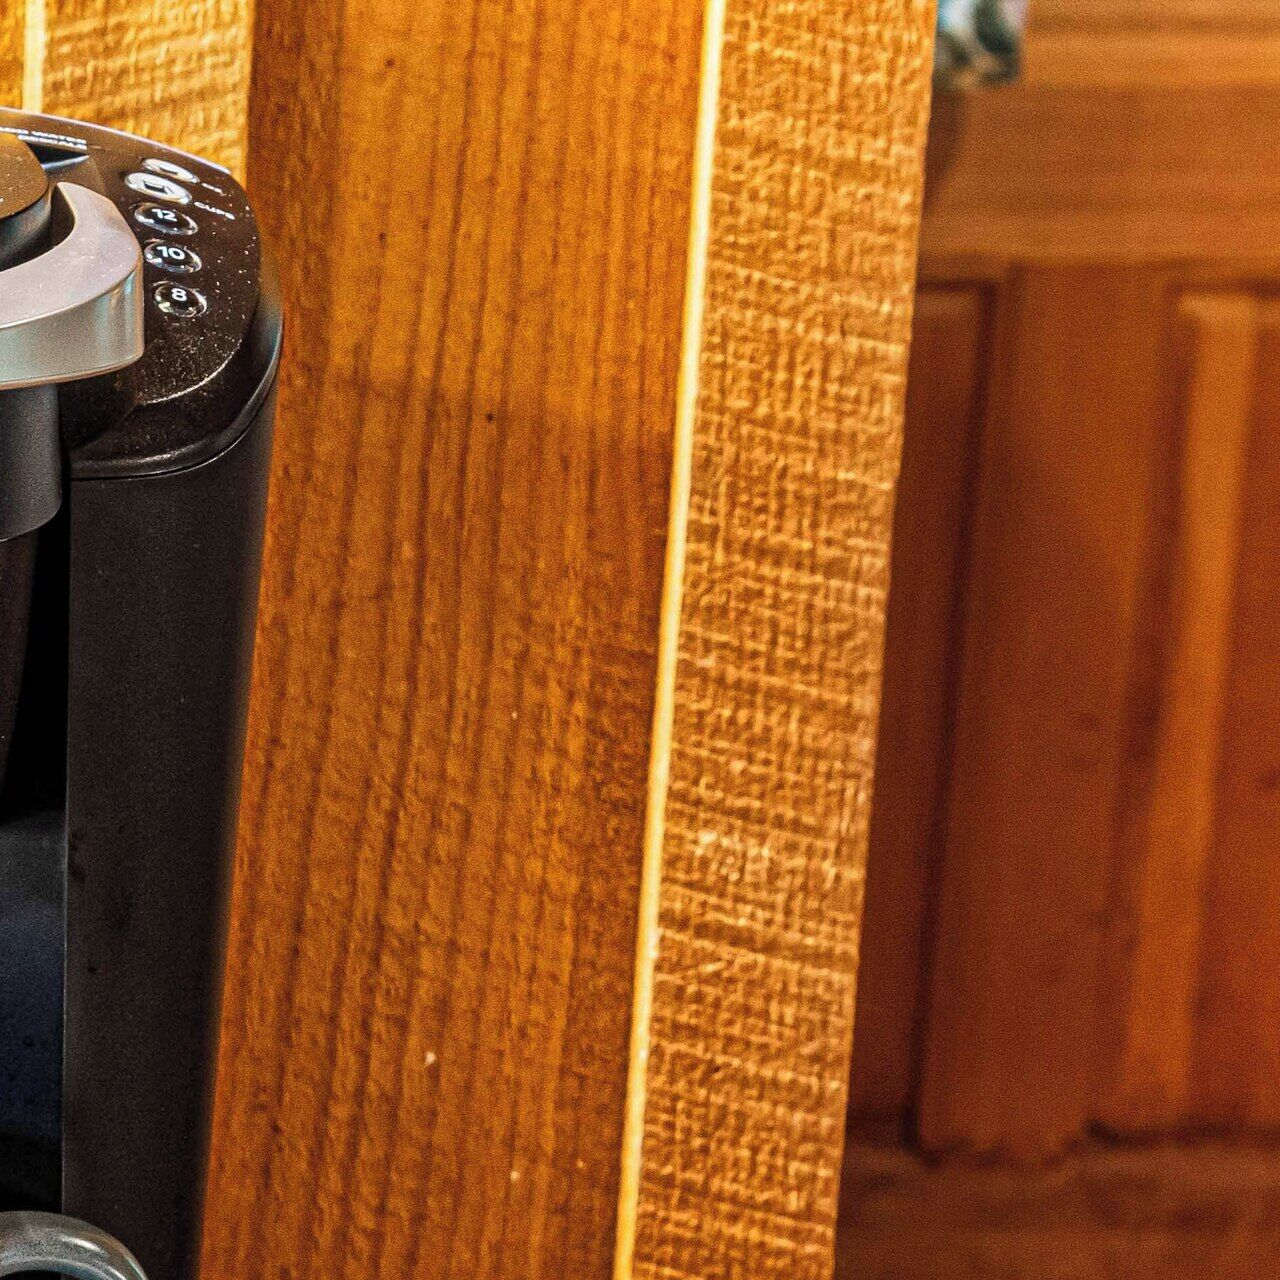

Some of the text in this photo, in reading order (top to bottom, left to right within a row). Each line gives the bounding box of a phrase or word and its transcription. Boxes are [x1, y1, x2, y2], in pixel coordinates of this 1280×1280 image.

[151, 208, 177, 222] 12
[156, 245, 186, 260] 10
[170, 287, 187, 302] 8
